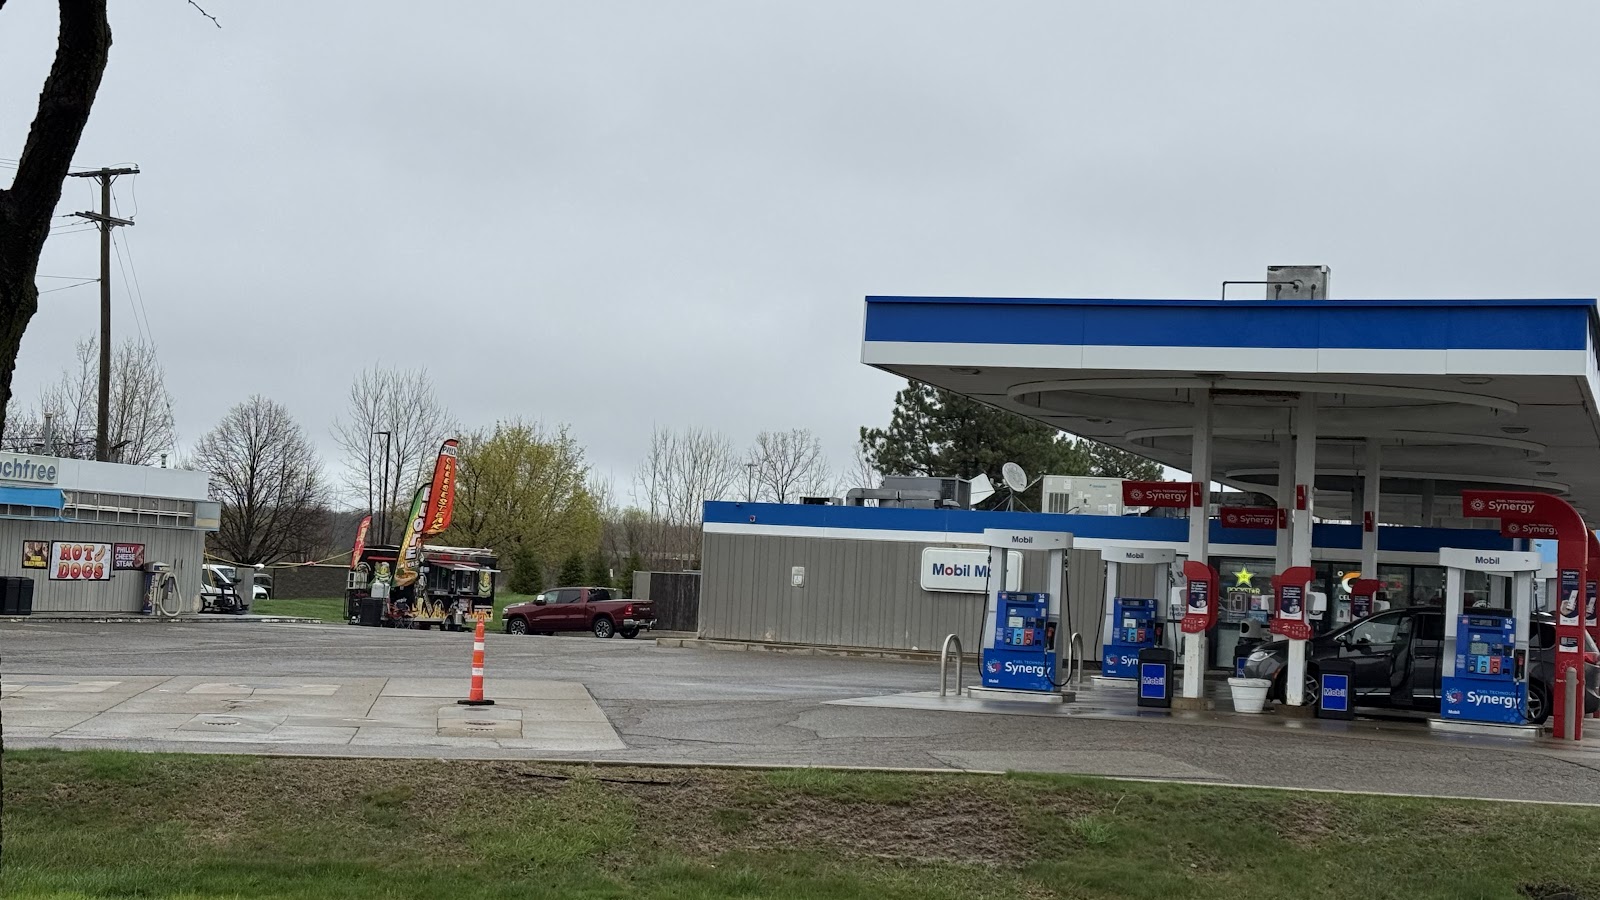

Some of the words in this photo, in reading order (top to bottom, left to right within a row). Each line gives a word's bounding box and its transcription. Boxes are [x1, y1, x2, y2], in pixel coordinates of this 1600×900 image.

[1146, 490, 1187, 502] Synergy
[1488, 501, 1535, 514] Synergy
[1240, 515, 1275, 525] Synergy
[1011, 535, 1034, 544] Mobil
[60, 544, 94, 561] HOT
[116, 560, 134, 568] STEAK
[1475, 556, 1500, 565] Mobil
[57, 562, 103, 580] DOGS
[932, 563, 970, 577] Mobil
[1121, 655, 1139, 669] Syn
[1142, 676, 1165, 686] Mobil
[1323, 687, 1346, 698] Mobil
[1467, 691, 1521, 709] Synergy
